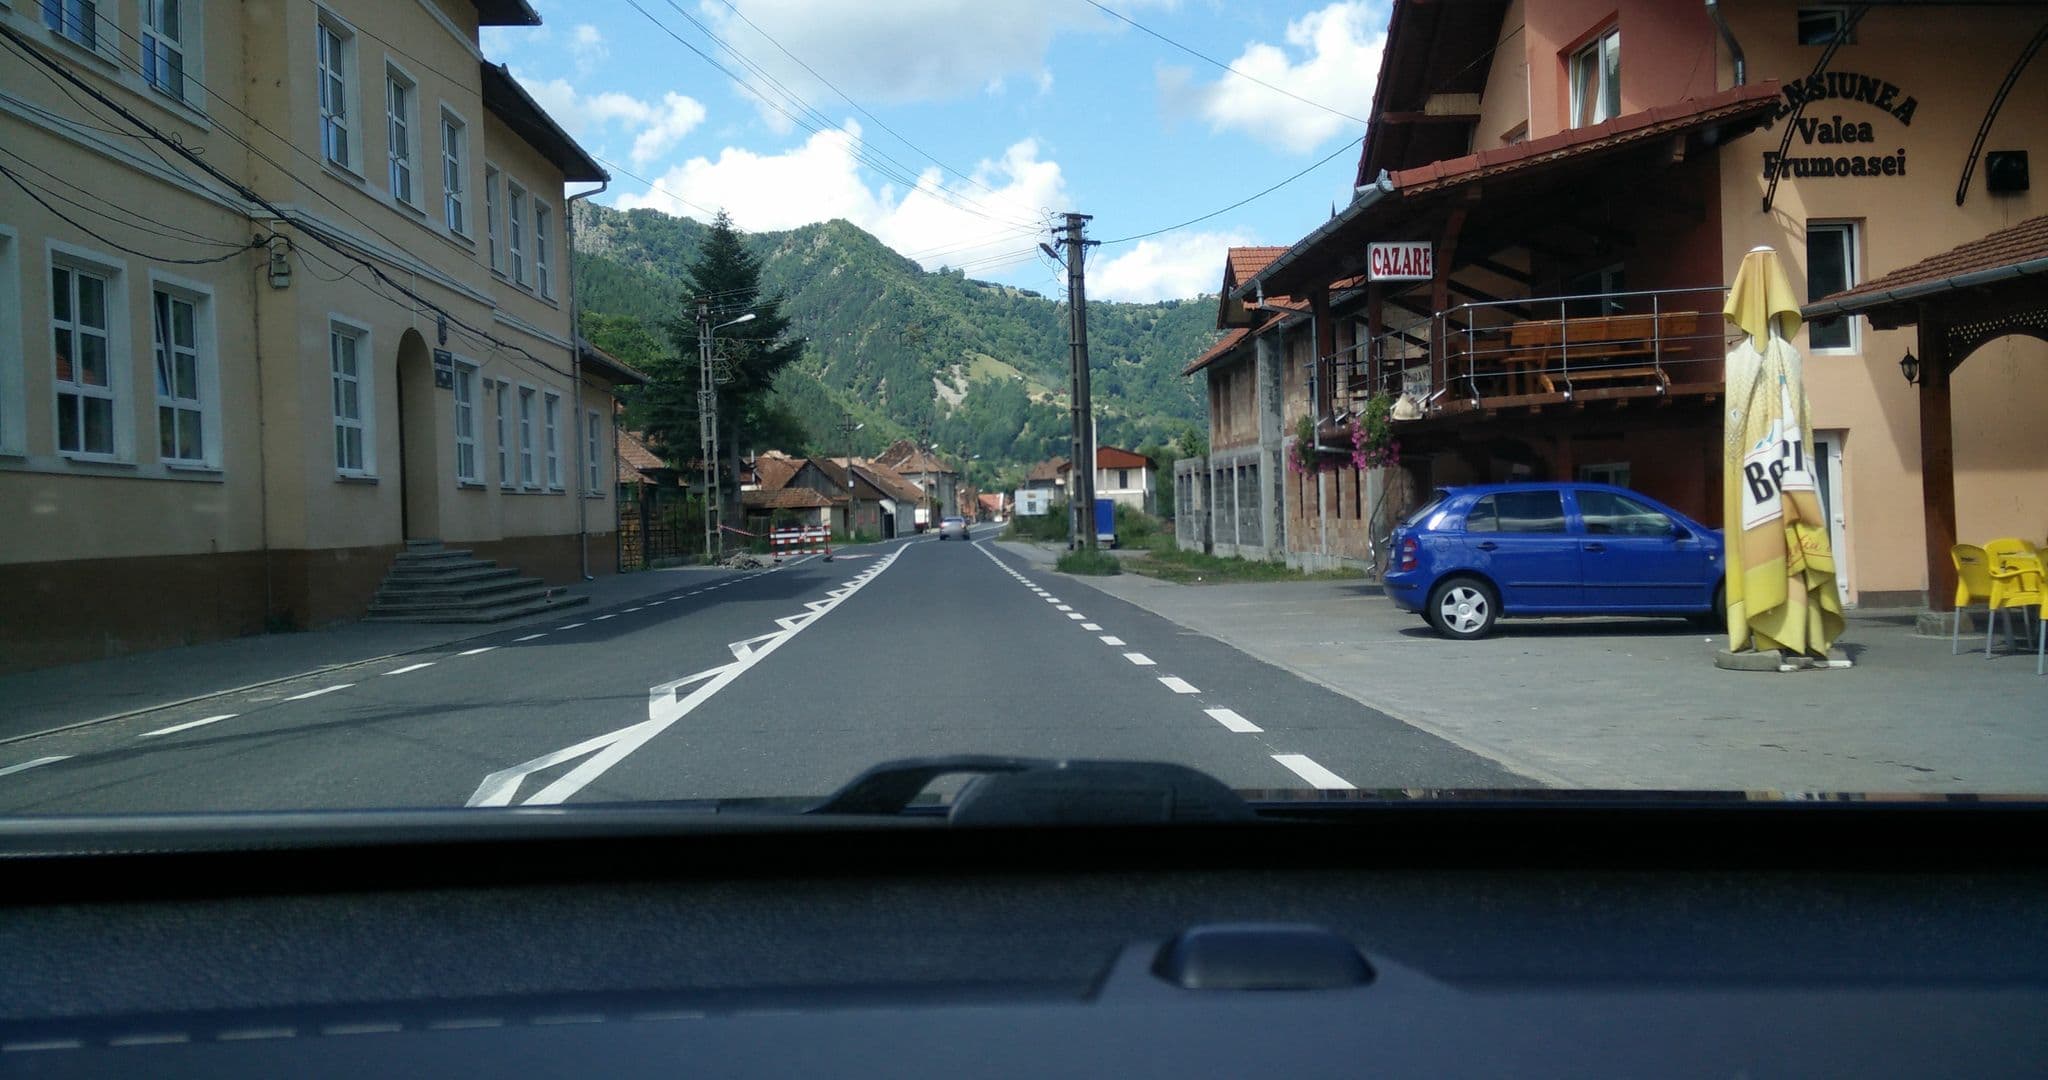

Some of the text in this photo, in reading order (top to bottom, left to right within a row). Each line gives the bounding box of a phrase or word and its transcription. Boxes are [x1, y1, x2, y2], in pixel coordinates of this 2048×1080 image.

[1766, 71, 1918, 127] NSIUNEA
[1799, 115, 1874, 144] Valea
[1763, 148, 1906, 179] Frumoasei
[1372, 247, 1431, 276] CAZARE
